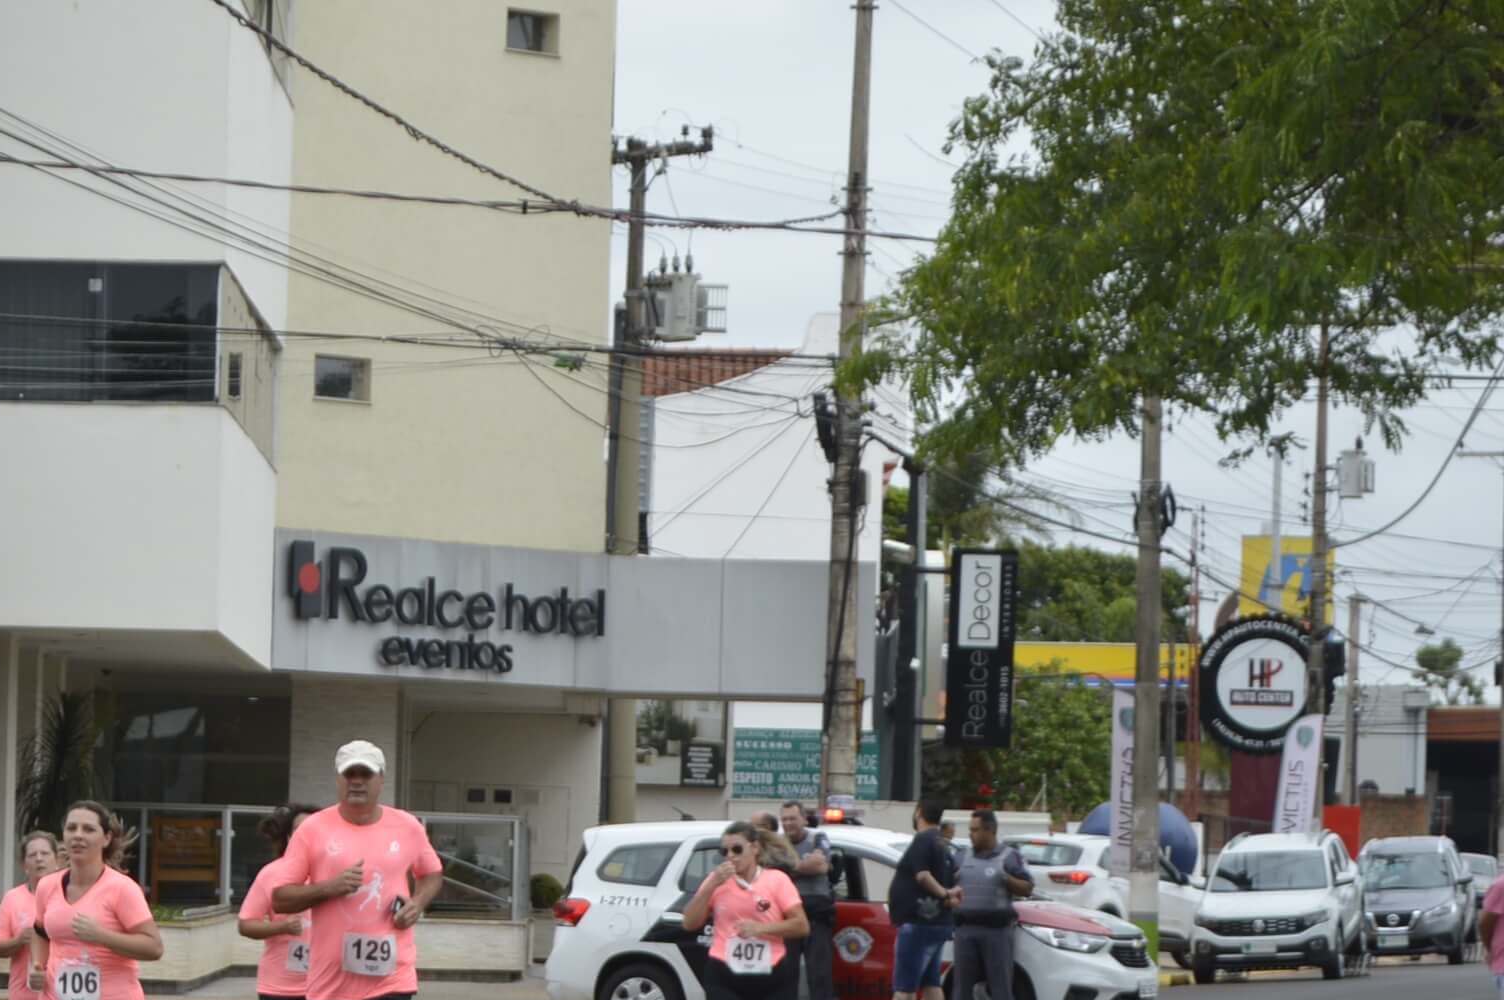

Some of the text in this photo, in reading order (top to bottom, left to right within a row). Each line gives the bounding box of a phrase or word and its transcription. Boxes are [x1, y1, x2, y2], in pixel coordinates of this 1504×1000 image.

[327, 547, 606, 637] Realce hotel
[379, 633, 514, 673] eventos
[962, 560, 993, 739] Realce Decor
[351, 939, 392, 962] 129
[731, 942, 766, 961] 407
[57, 971, 98, 995] 106
